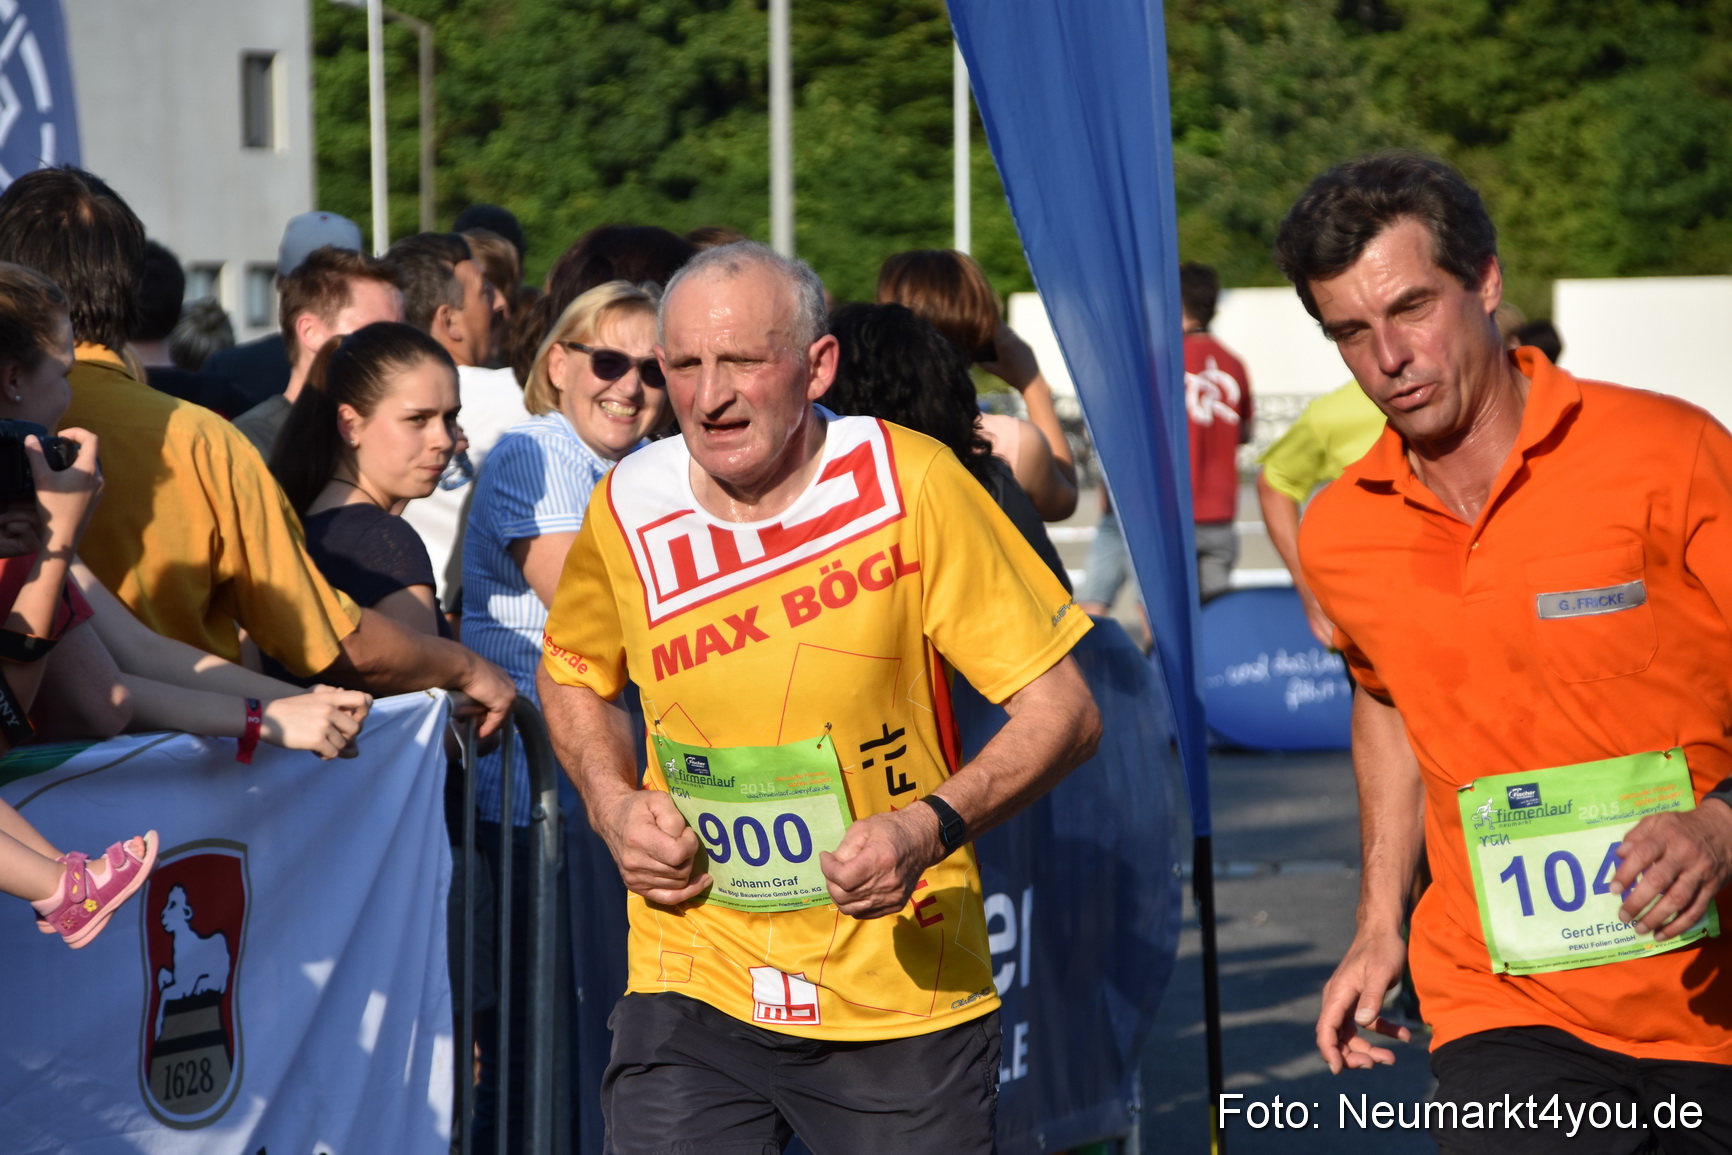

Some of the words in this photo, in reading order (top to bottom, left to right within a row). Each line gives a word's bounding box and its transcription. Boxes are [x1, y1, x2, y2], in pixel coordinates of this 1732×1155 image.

[651, 605, 770, 682] MAX
[780, 542, 920, 628] BÖGL
[0, 688, 20, 728] ONY
[678, 770, 735, 788] firmenlauf
[741, 782, 776, 795] 2015
[1509, 787, 1536, 798] Fischer
[1497, 799, 1574, 823] firmenlauf
[1578, 801, 1621, 820] 2015
[1498, 820, 1533, 828] neumarkt
[698, 812, 813, 867] 900
[730, 877, 771, 889] Johann
[772, 876, 799, 887] Graf
[1500, 841, 1664, 917] 104
[1561, 925, 1594, 940] Gerd
[1597, 919, 1639, 937] Fricke
[1568, 943, 1590, 951] PEKU
[1591, 940, 1613, 949] Folien
[1614, 934, 1637, 945] GmbH
[163, 1057, 214, 1101] 1628
